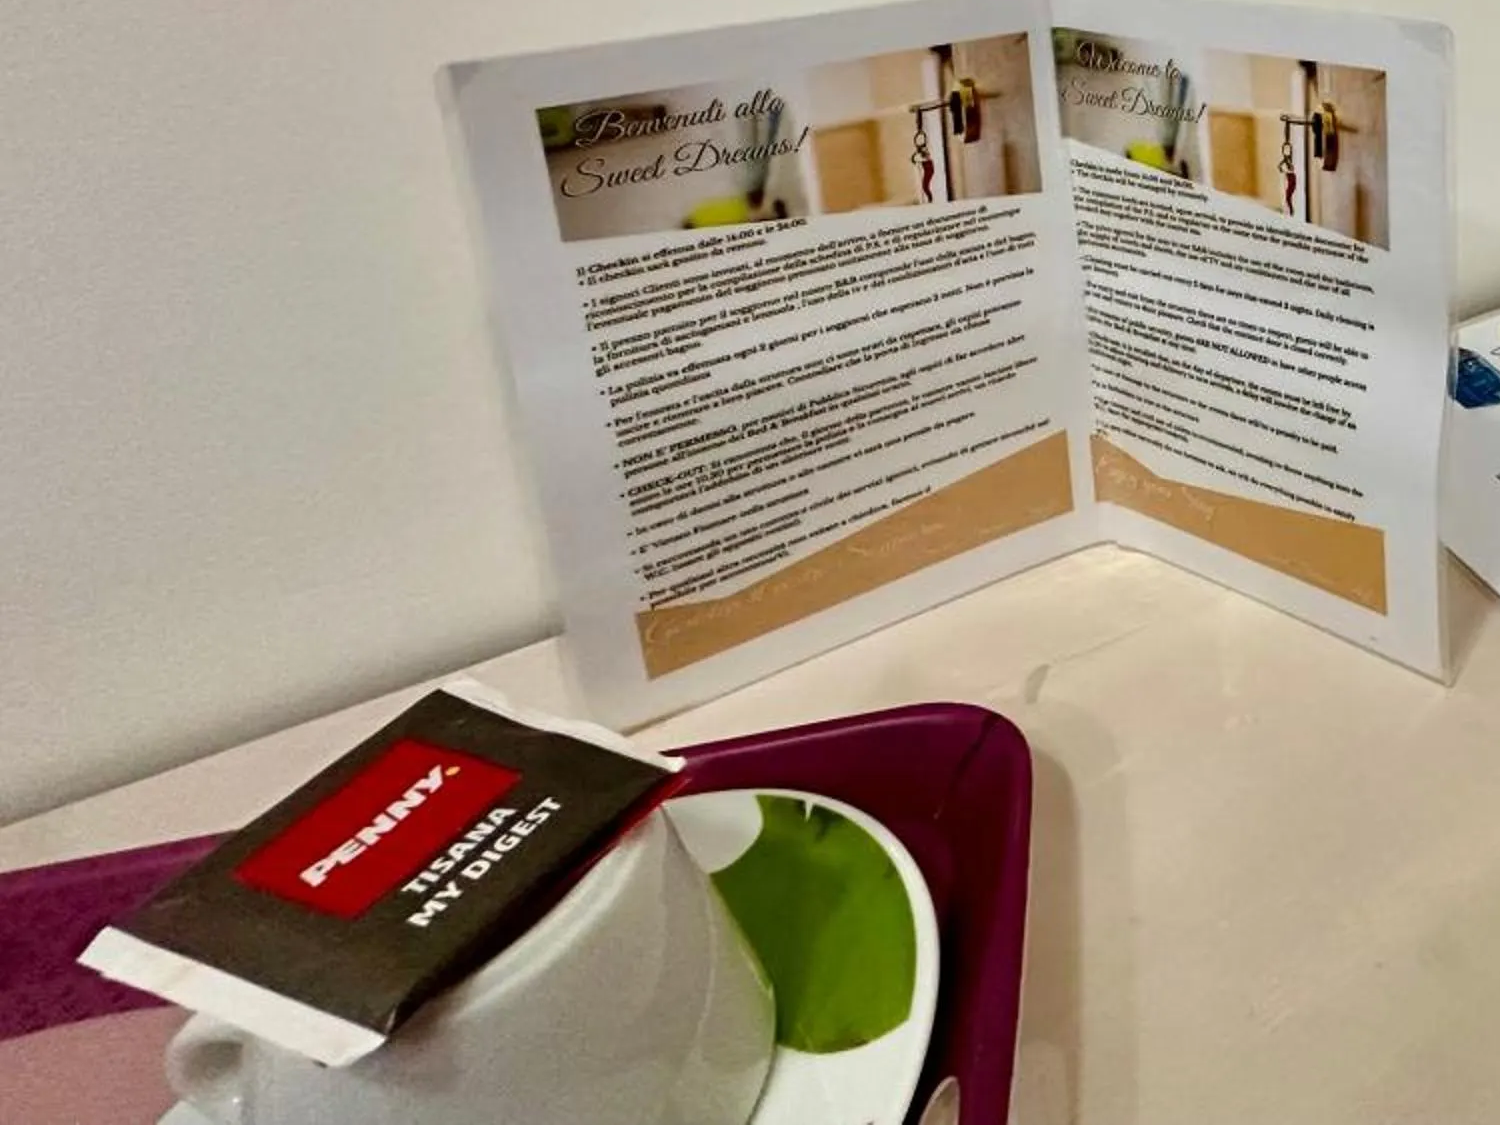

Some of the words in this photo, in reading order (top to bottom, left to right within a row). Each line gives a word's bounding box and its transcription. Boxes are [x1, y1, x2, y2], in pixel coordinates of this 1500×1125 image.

[1076, 43, 1159, 78] Welcome
[1160, 58, 1182, 80] to
[575, 98, 726, 150] Benvenuti
[734, 89, 785, 121] alla
[1062, 79, 1118, 108] Sweet
[1121, 87, 1207, 124] Dreams!
[560, 155, 664, 200] Sweet
[674, 125, 811, 178] Dreams!
[401, 806, 518, 895] TISANA
[406, 880, 462, 927] MY
[459, 795, 562, 882] DIGEST
